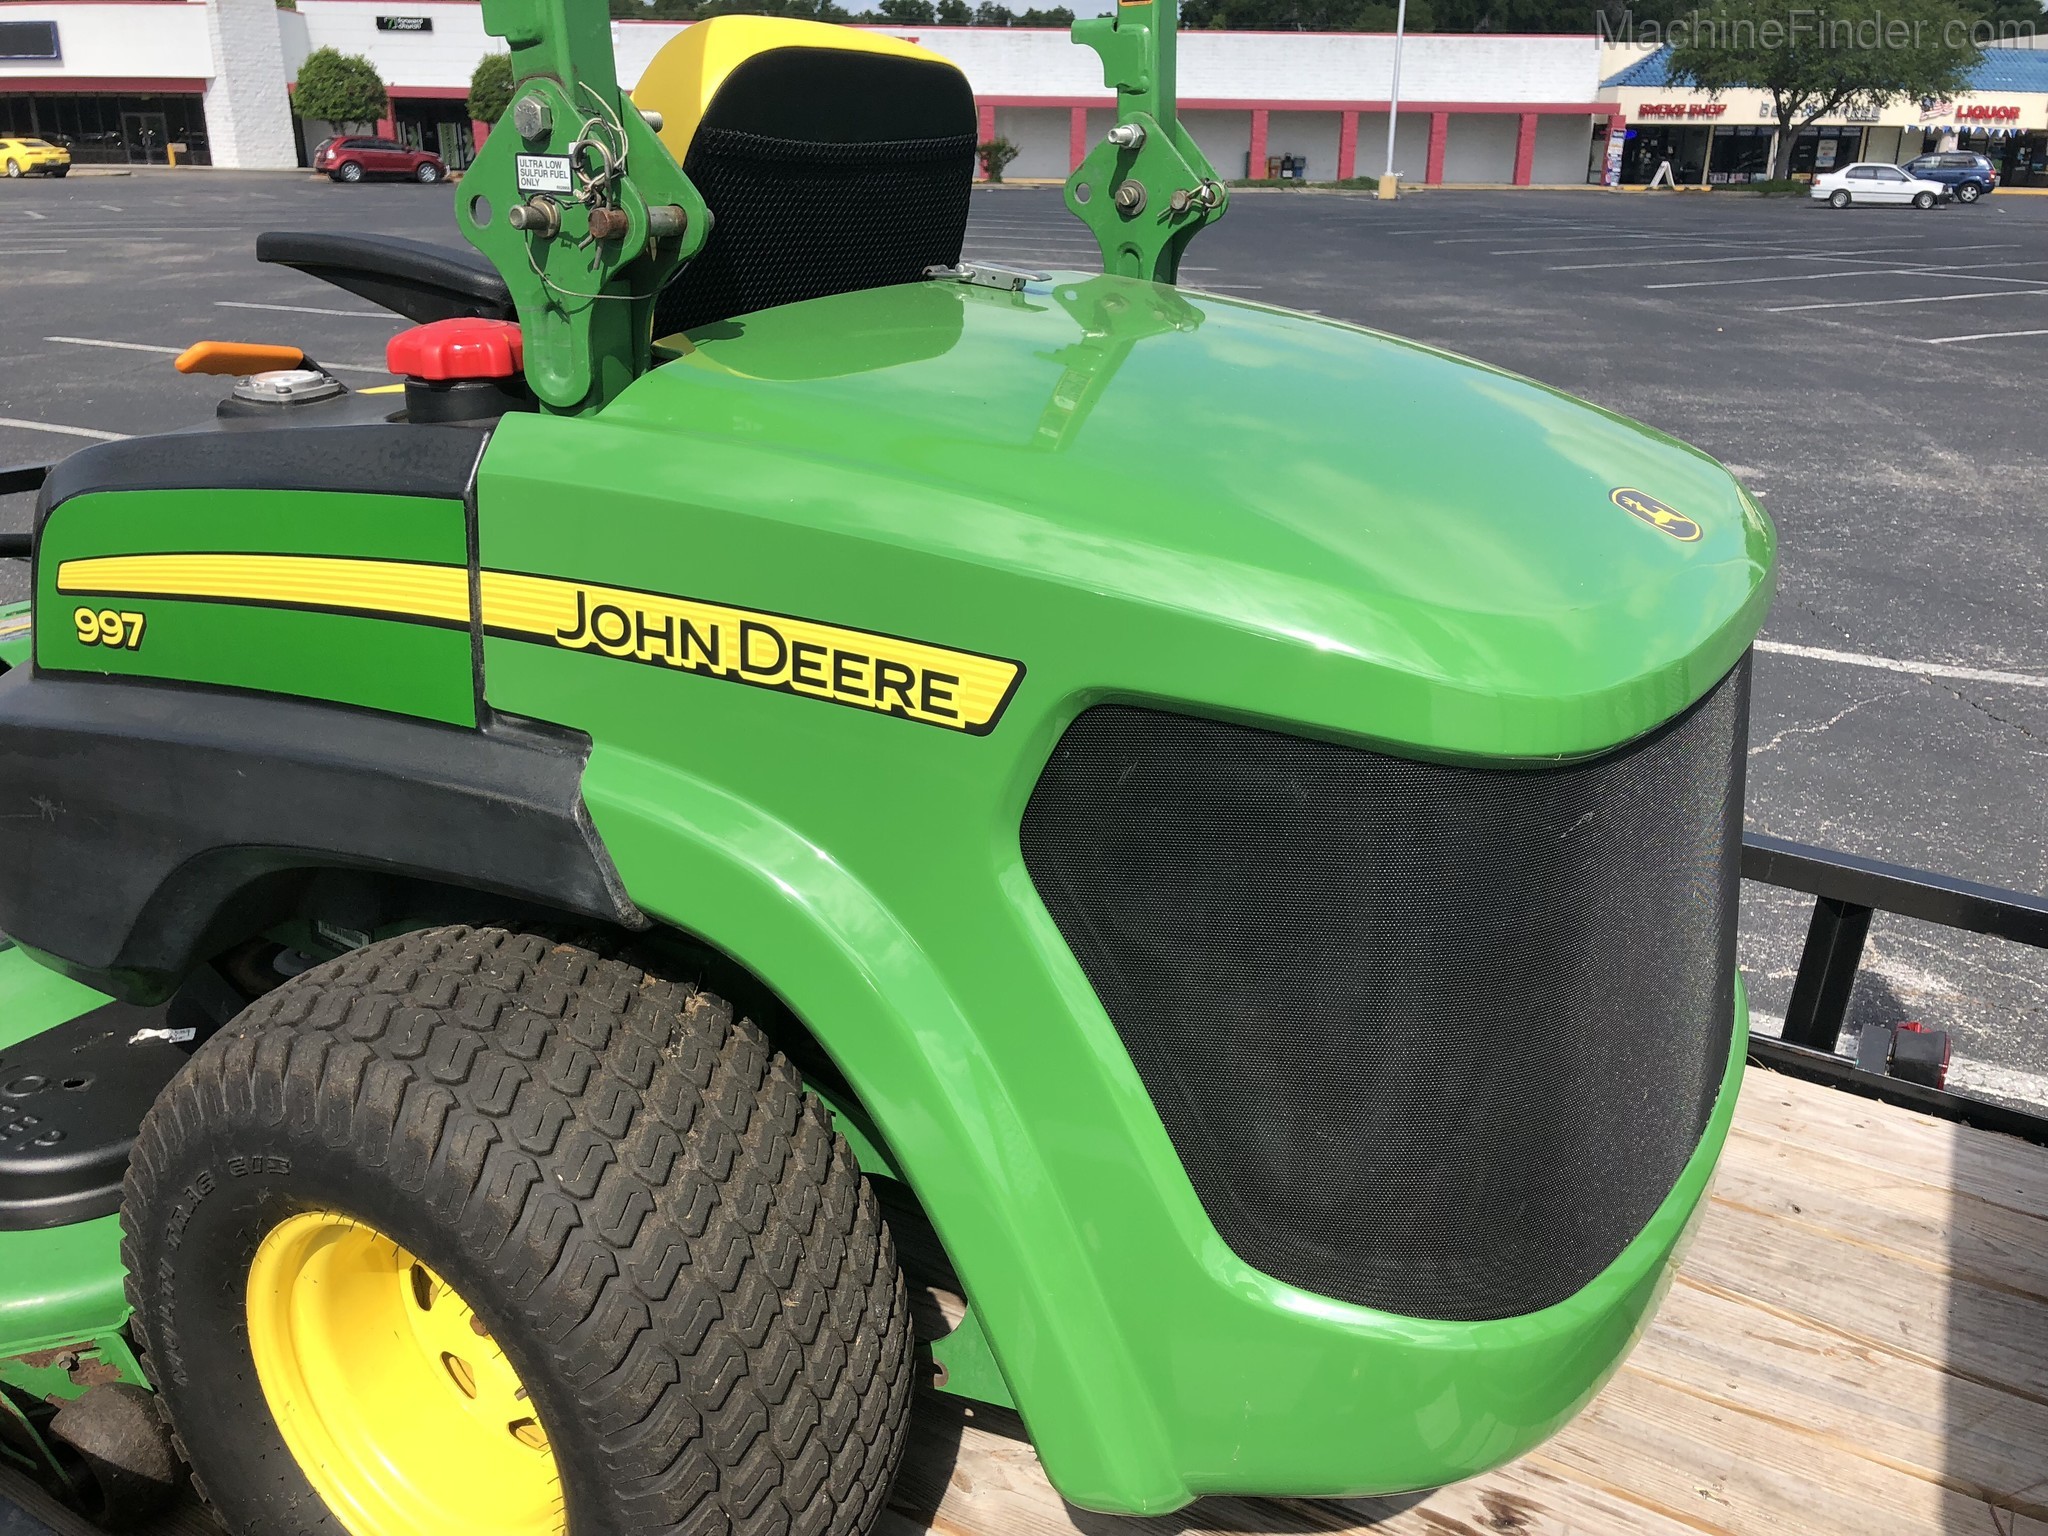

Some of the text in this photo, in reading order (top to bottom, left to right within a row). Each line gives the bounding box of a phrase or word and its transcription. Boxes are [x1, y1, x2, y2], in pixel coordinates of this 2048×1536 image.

[1956, 105, 2020, 120] LIQUOR
[519, 159, 563, 169] ULTRA LOW
[520, 168, 569, 179] SULFUR FUEL
[520, 178, 540, 187] ONLY
[74, 606, 146, 650] 997
[556, 590, 961, 719] JOHN DEERE
